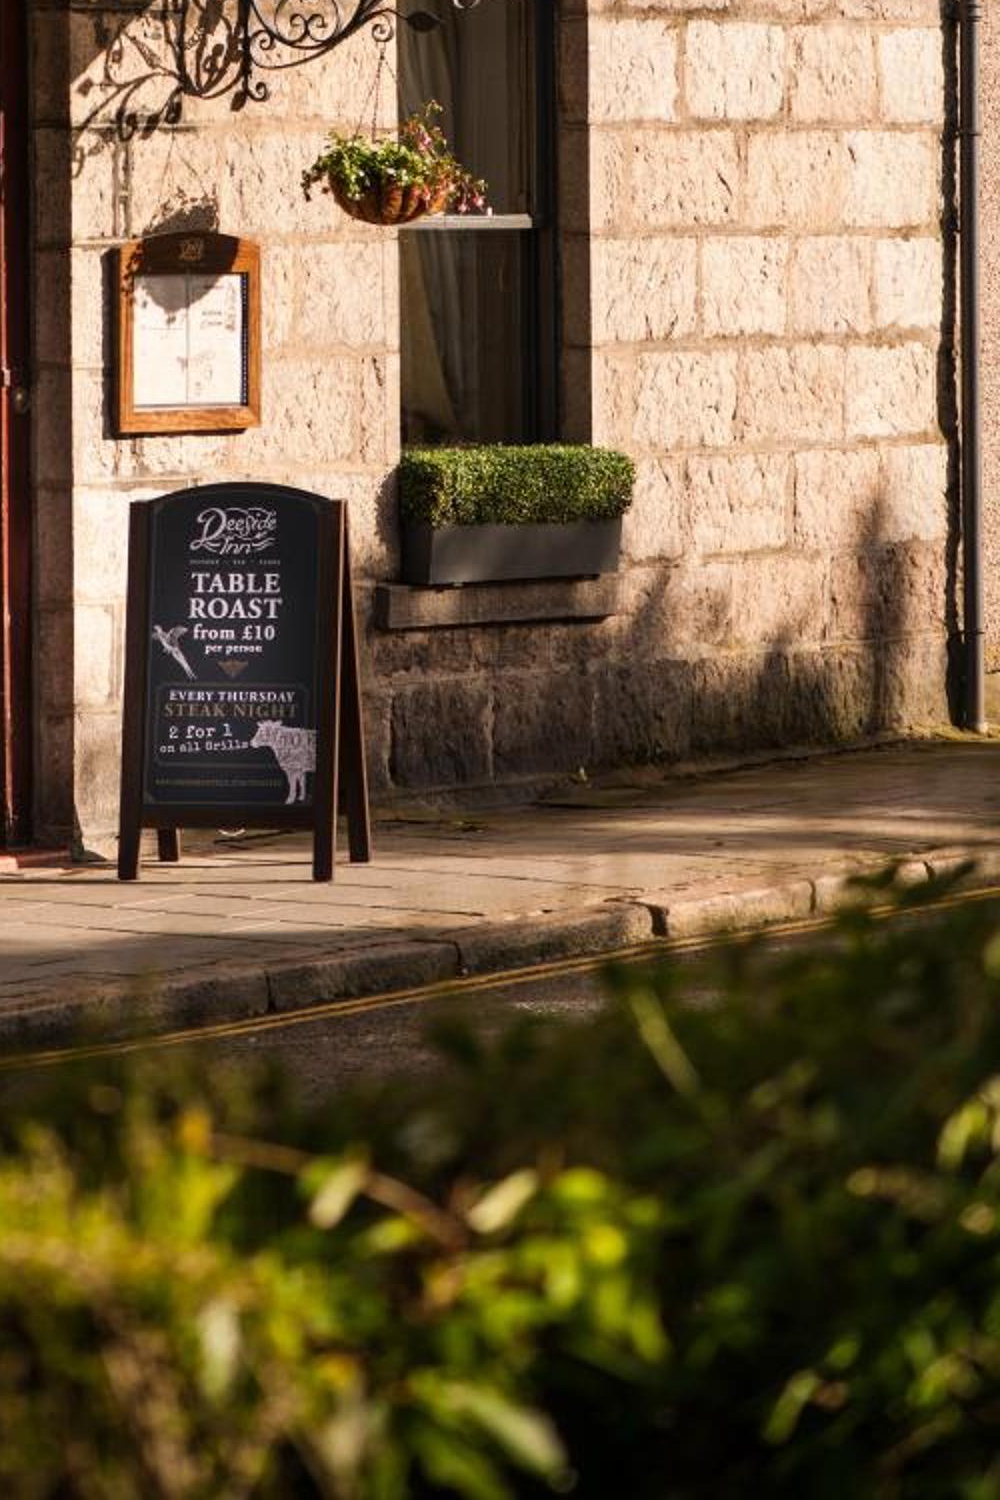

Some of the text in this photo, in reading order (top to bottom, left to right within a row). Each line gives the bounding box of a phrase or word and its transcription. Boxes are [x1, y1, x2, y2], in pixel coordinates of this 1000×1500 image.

[189, 507, 277, 551] Deeside
[218, 536, 252, 555] Inn
[191, 572, 281, 594] TABLE
[187, 597, 283, 619] ROAST
[192, 623, 276, 641] from £10
[204, 644, 263, 655] per person
[169, 689, 296, 703] EVERY THURSDAY
[164, 703, 297, 717] STEAK NIGHT
[169, 725, 179, 739] 2
[185, 725, 217, 739] for
[159, 744, 176, 753] on
